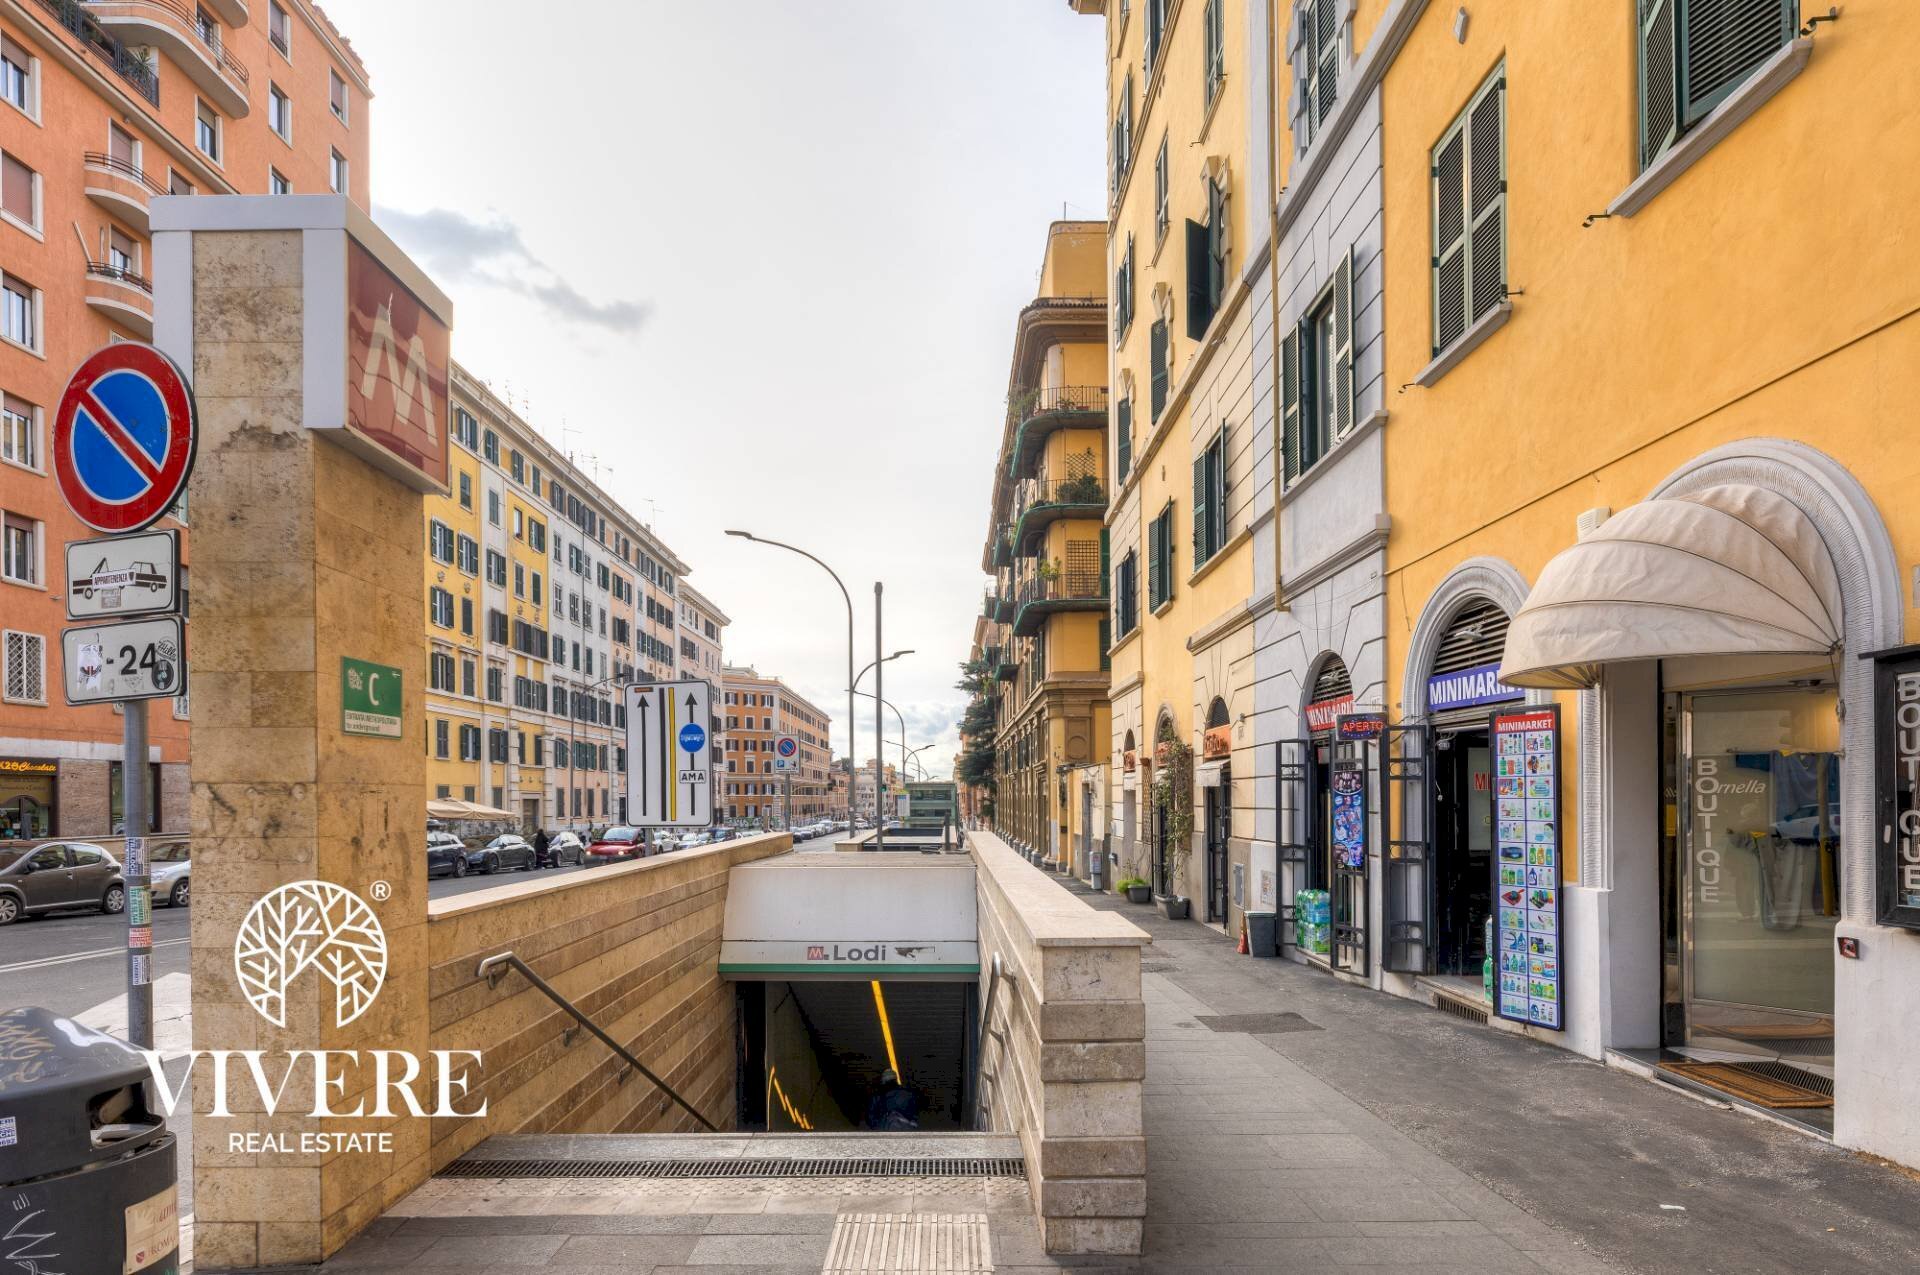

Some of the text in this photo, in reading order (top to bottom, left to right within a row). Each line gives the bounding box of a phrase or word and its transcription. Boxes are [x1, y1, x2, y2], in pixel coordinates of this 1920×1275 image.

[368, 672, 380, 706] C
[1342, 721, 1384, 732] APERTO
[1498, 719, 1552, 732] MINIMARKET
[681, 772, 705, 781] AMA
[1695, 758, 1721, 904] BOUTIQUE
[833, 944, 886, 961] Lodi
